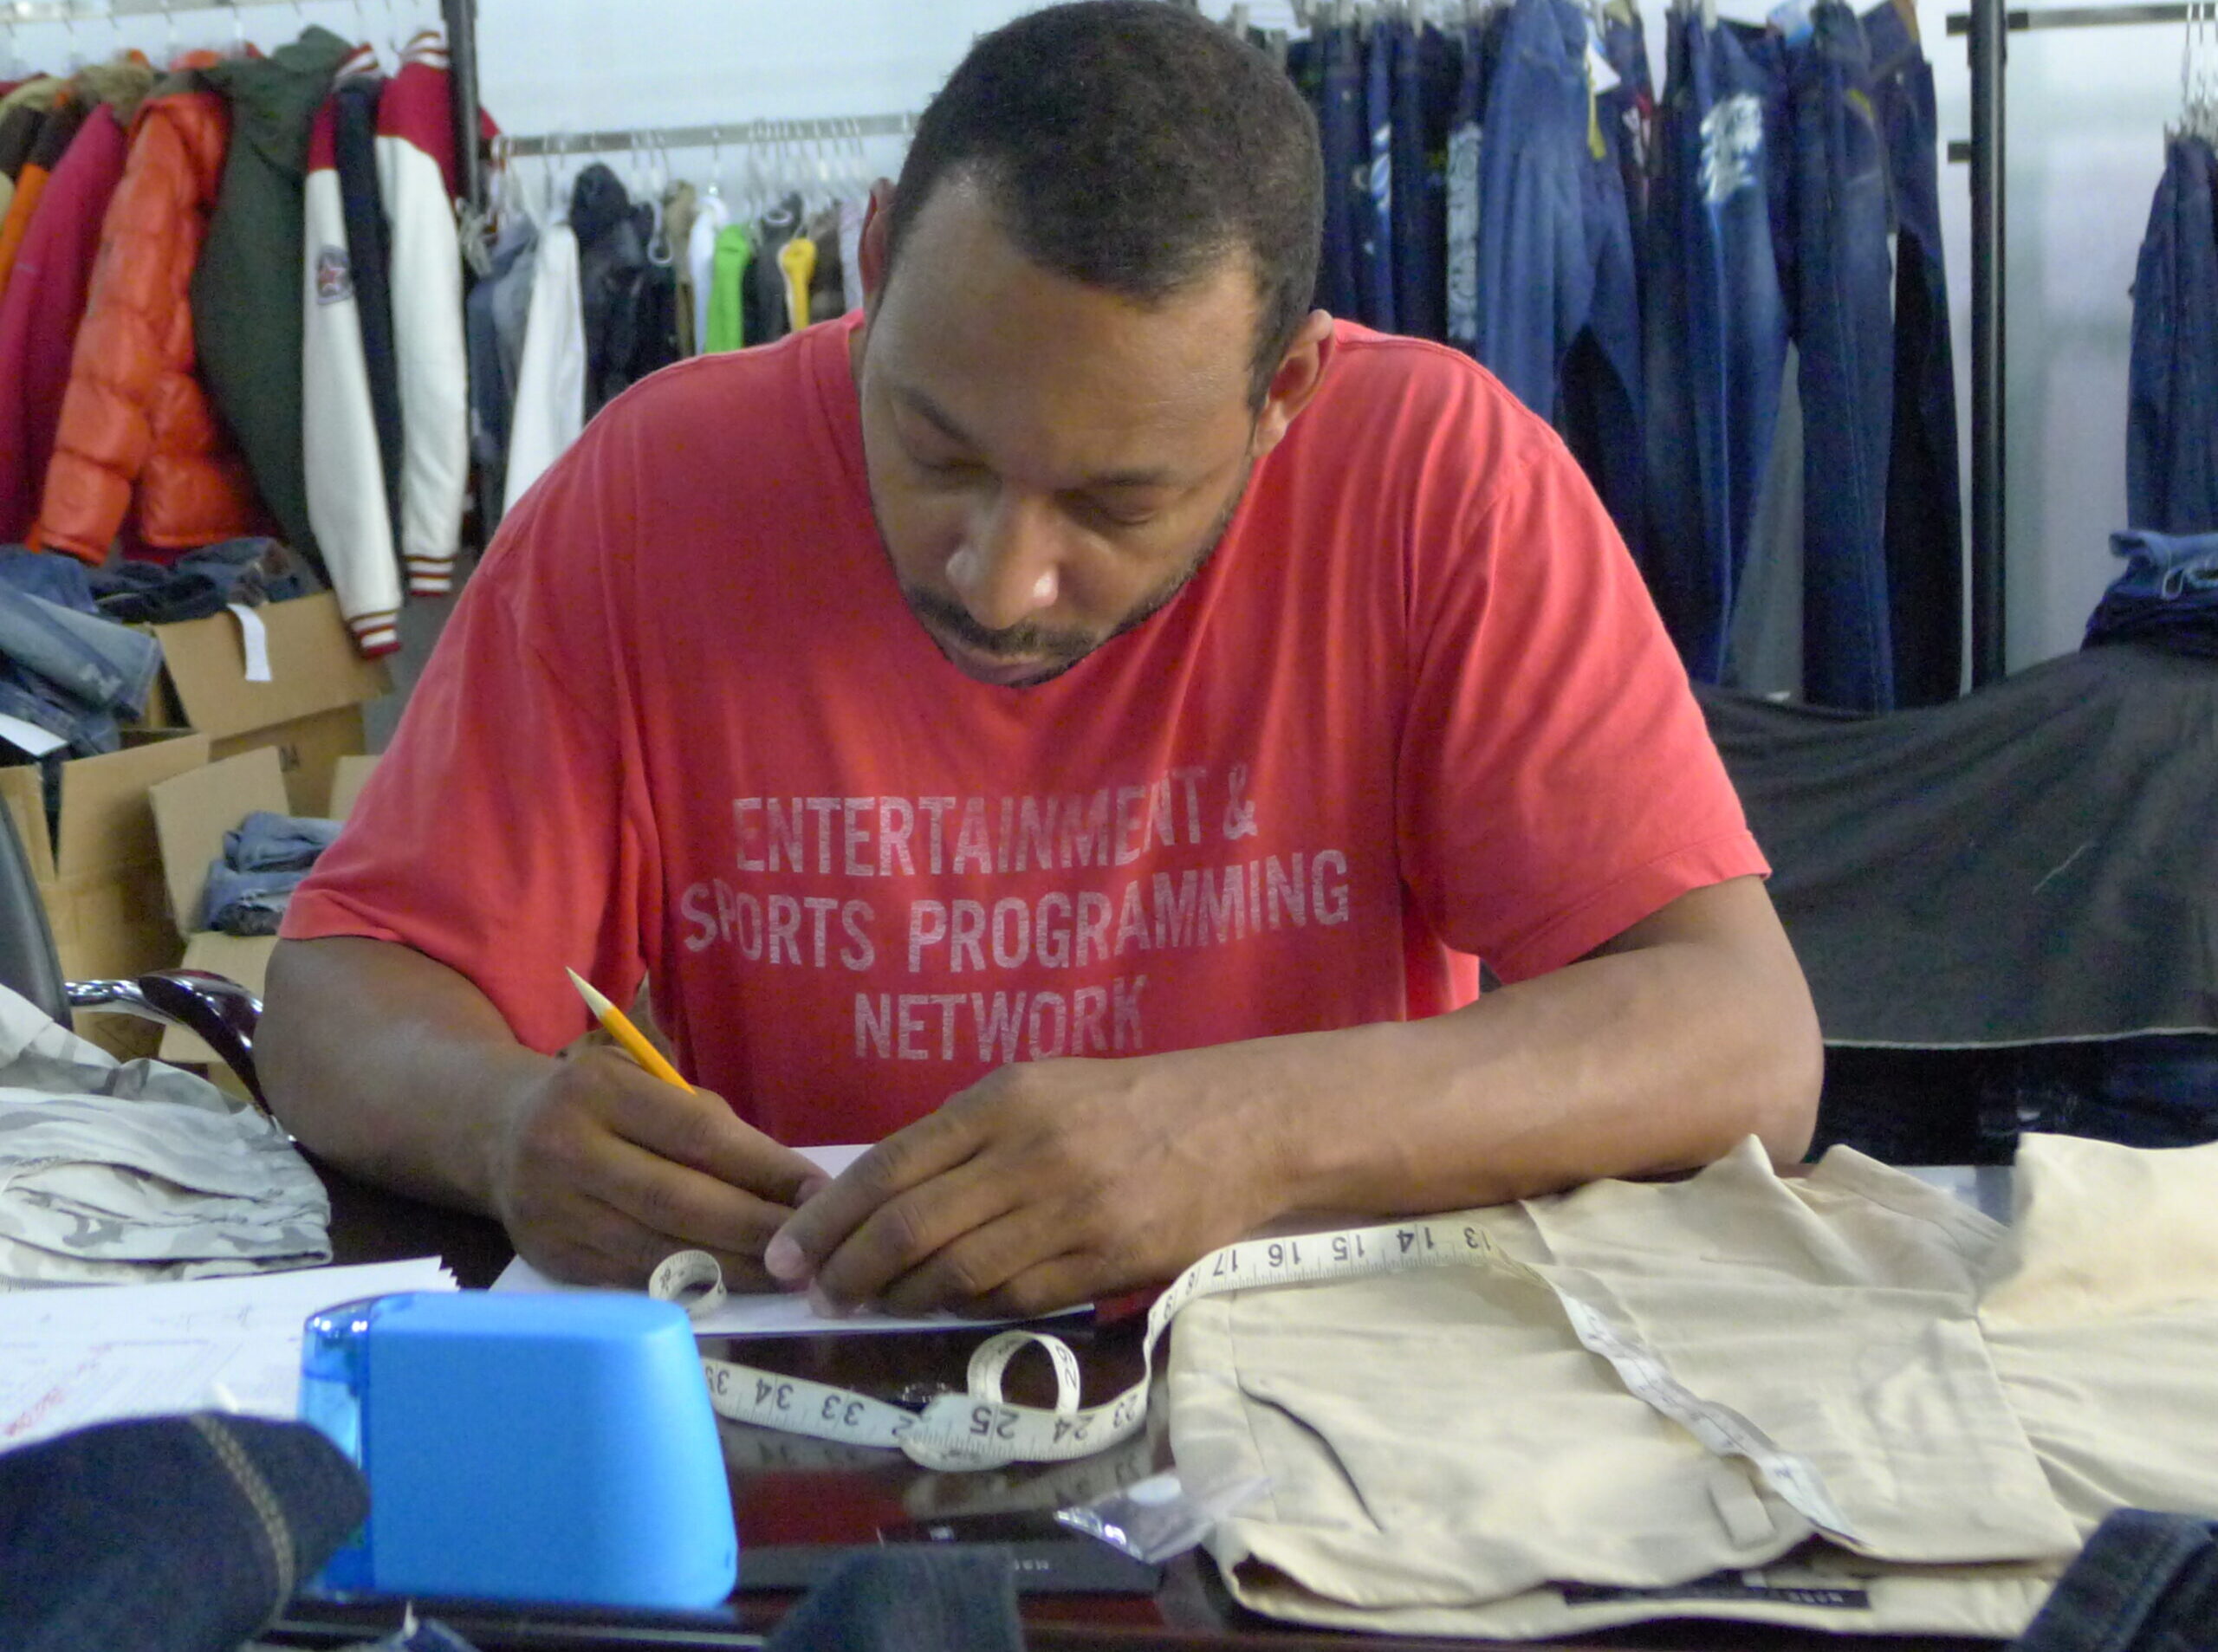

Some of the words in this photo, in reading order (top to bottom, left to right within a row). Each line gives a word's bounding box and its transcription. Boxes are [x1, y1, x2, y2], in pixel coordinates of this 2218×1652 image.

[732, 766, 1207, 877] ENTERTAINMENT
[1222, 761, 1259, 840] &
[680, 878, 876, 973] SPORTS
[908, 849, 1349, 973] PROGRAMMING
[854, 975, 1148, 1064] NETWORK
[1268, 1241, 1301, 1268] 16
[1332, 1234, 1365, 1261] 15
[1396, 1226, 1435, 1254] 14
[1463, 1227, 1491, 1252] 13
[1213, 1248, 1238, 1277] 17
[756, 1377, 794, 1410] 34
[821, 1394, 866, 1427] 33
[970, 1405, 1019, 1440] 25
[1053, 1413, 1094, 1443] 24
